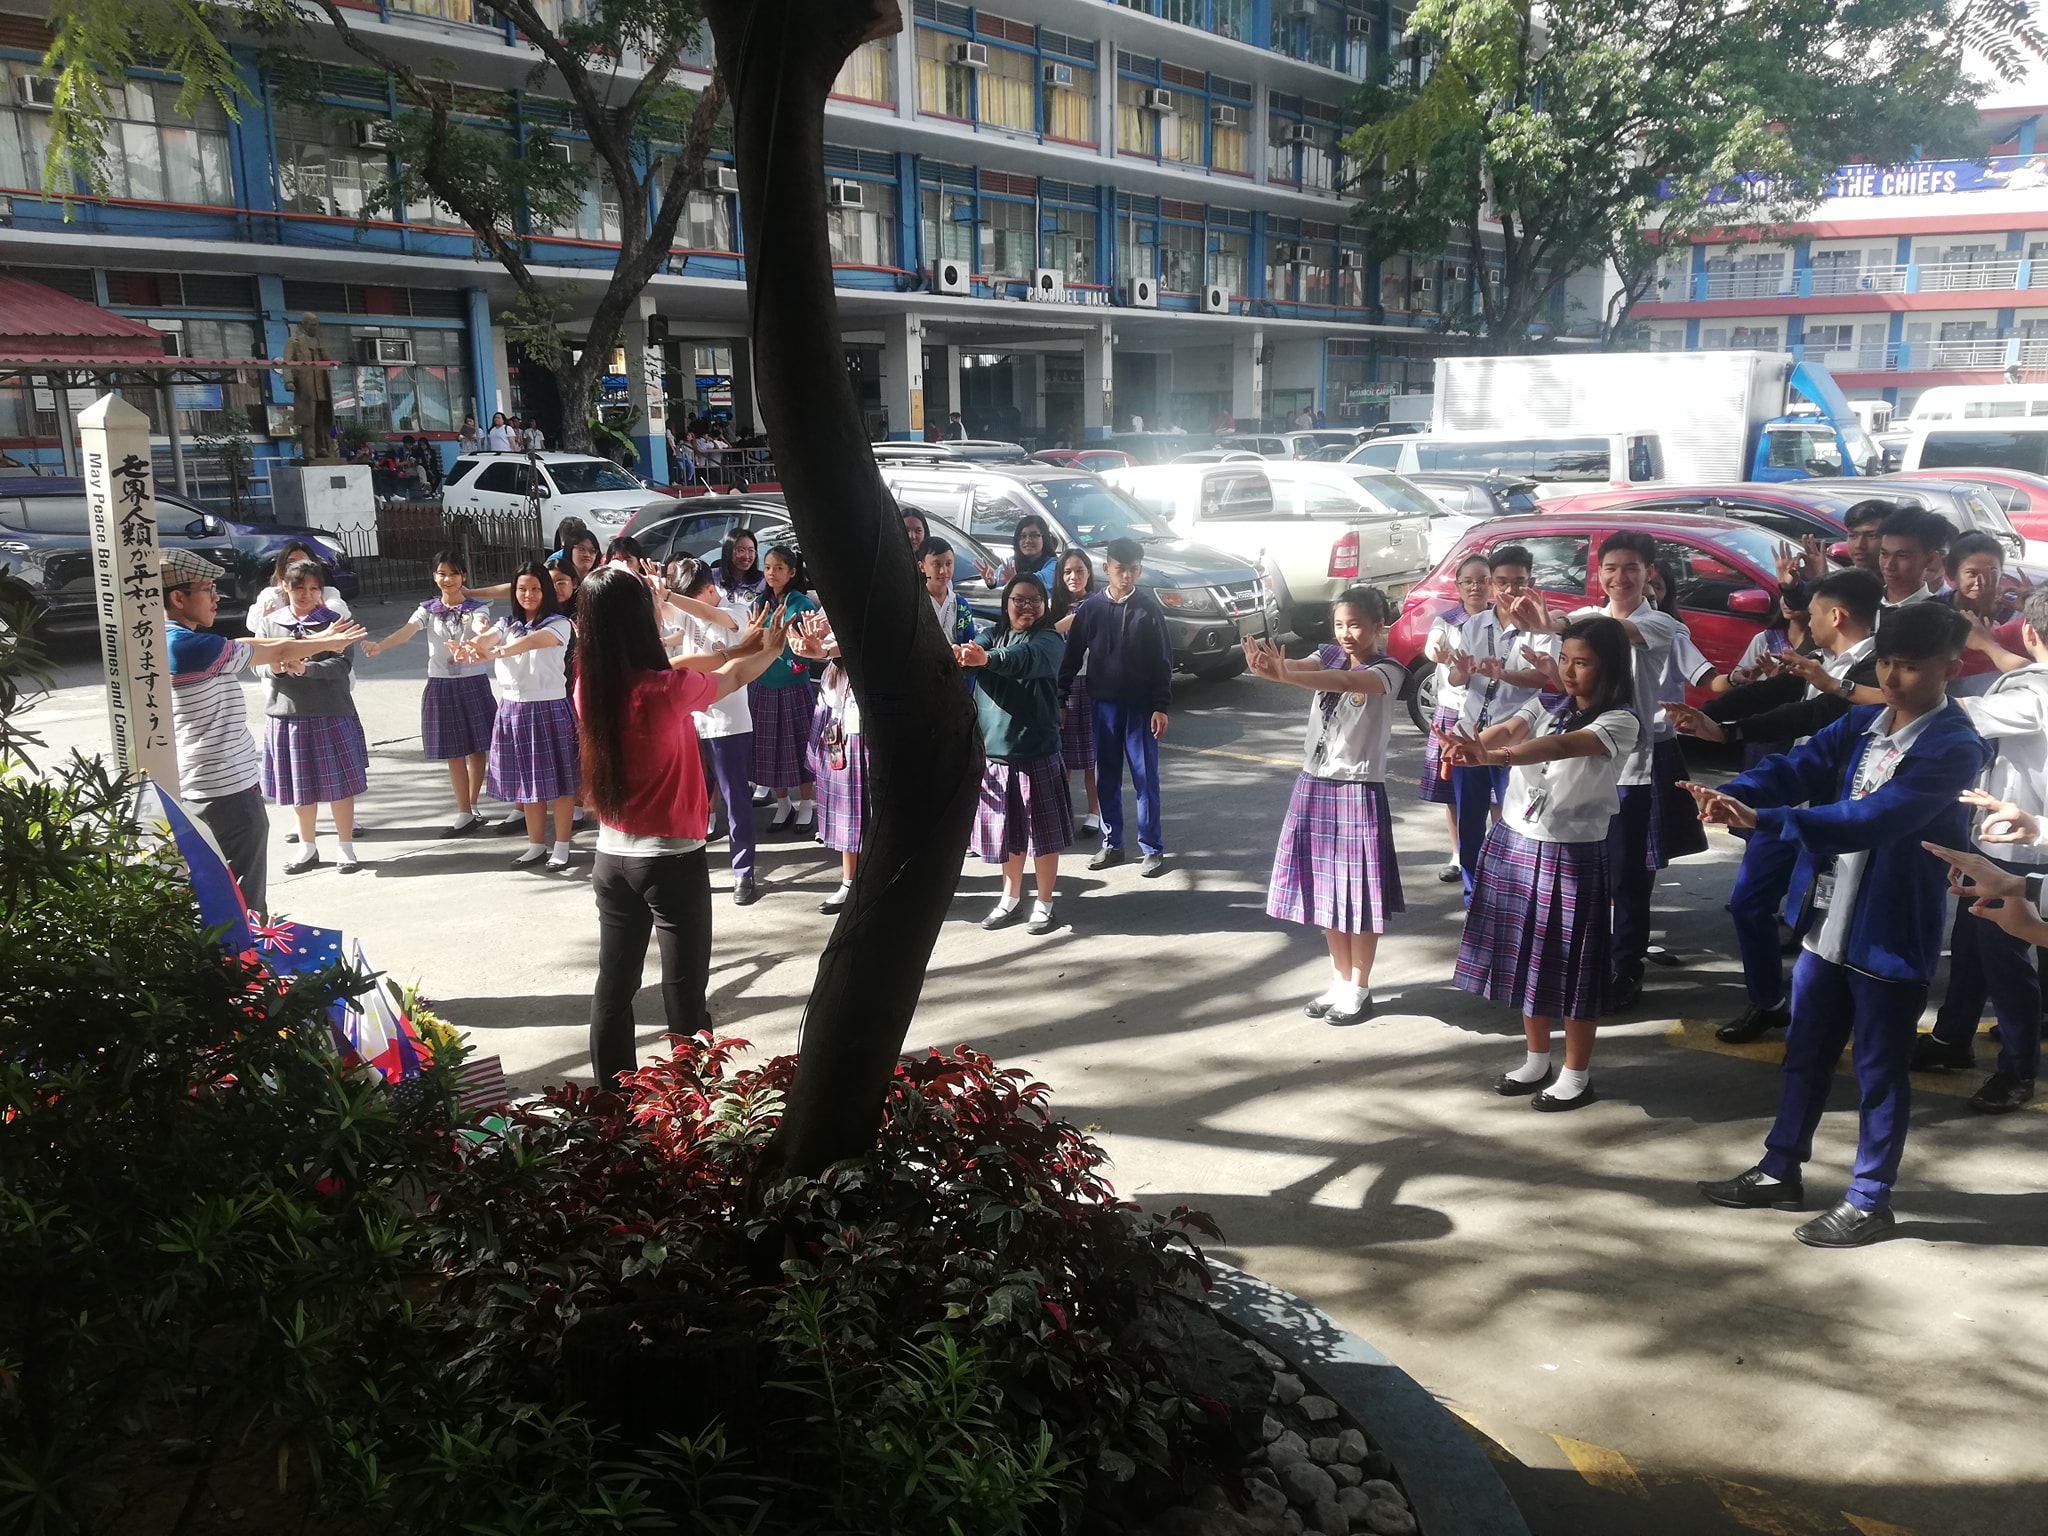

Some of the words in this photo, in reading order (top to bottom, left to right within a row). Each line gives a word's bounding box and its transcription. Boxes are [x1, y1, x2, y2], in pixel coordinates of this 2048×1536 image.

[1836, 173, 1874, 197] THE
[1881, 170, 1957, 195] CHIEFS
[1026, 286, 1079, 304] PLARIDEL
[1085, 291, 1111, 306] HALL
[89, 453, 101, 488] May
[93, 493, 106, 543] Peace
[98, 548, 110, 568] Be
[101, 574, 112, 587] in
[102, 592, 115, 619] Our
[112, 454, 168, 749] 世界人類が平和でありますように
[105, 624, 119, 677] Homes
[110, 681, 125, 709] and
